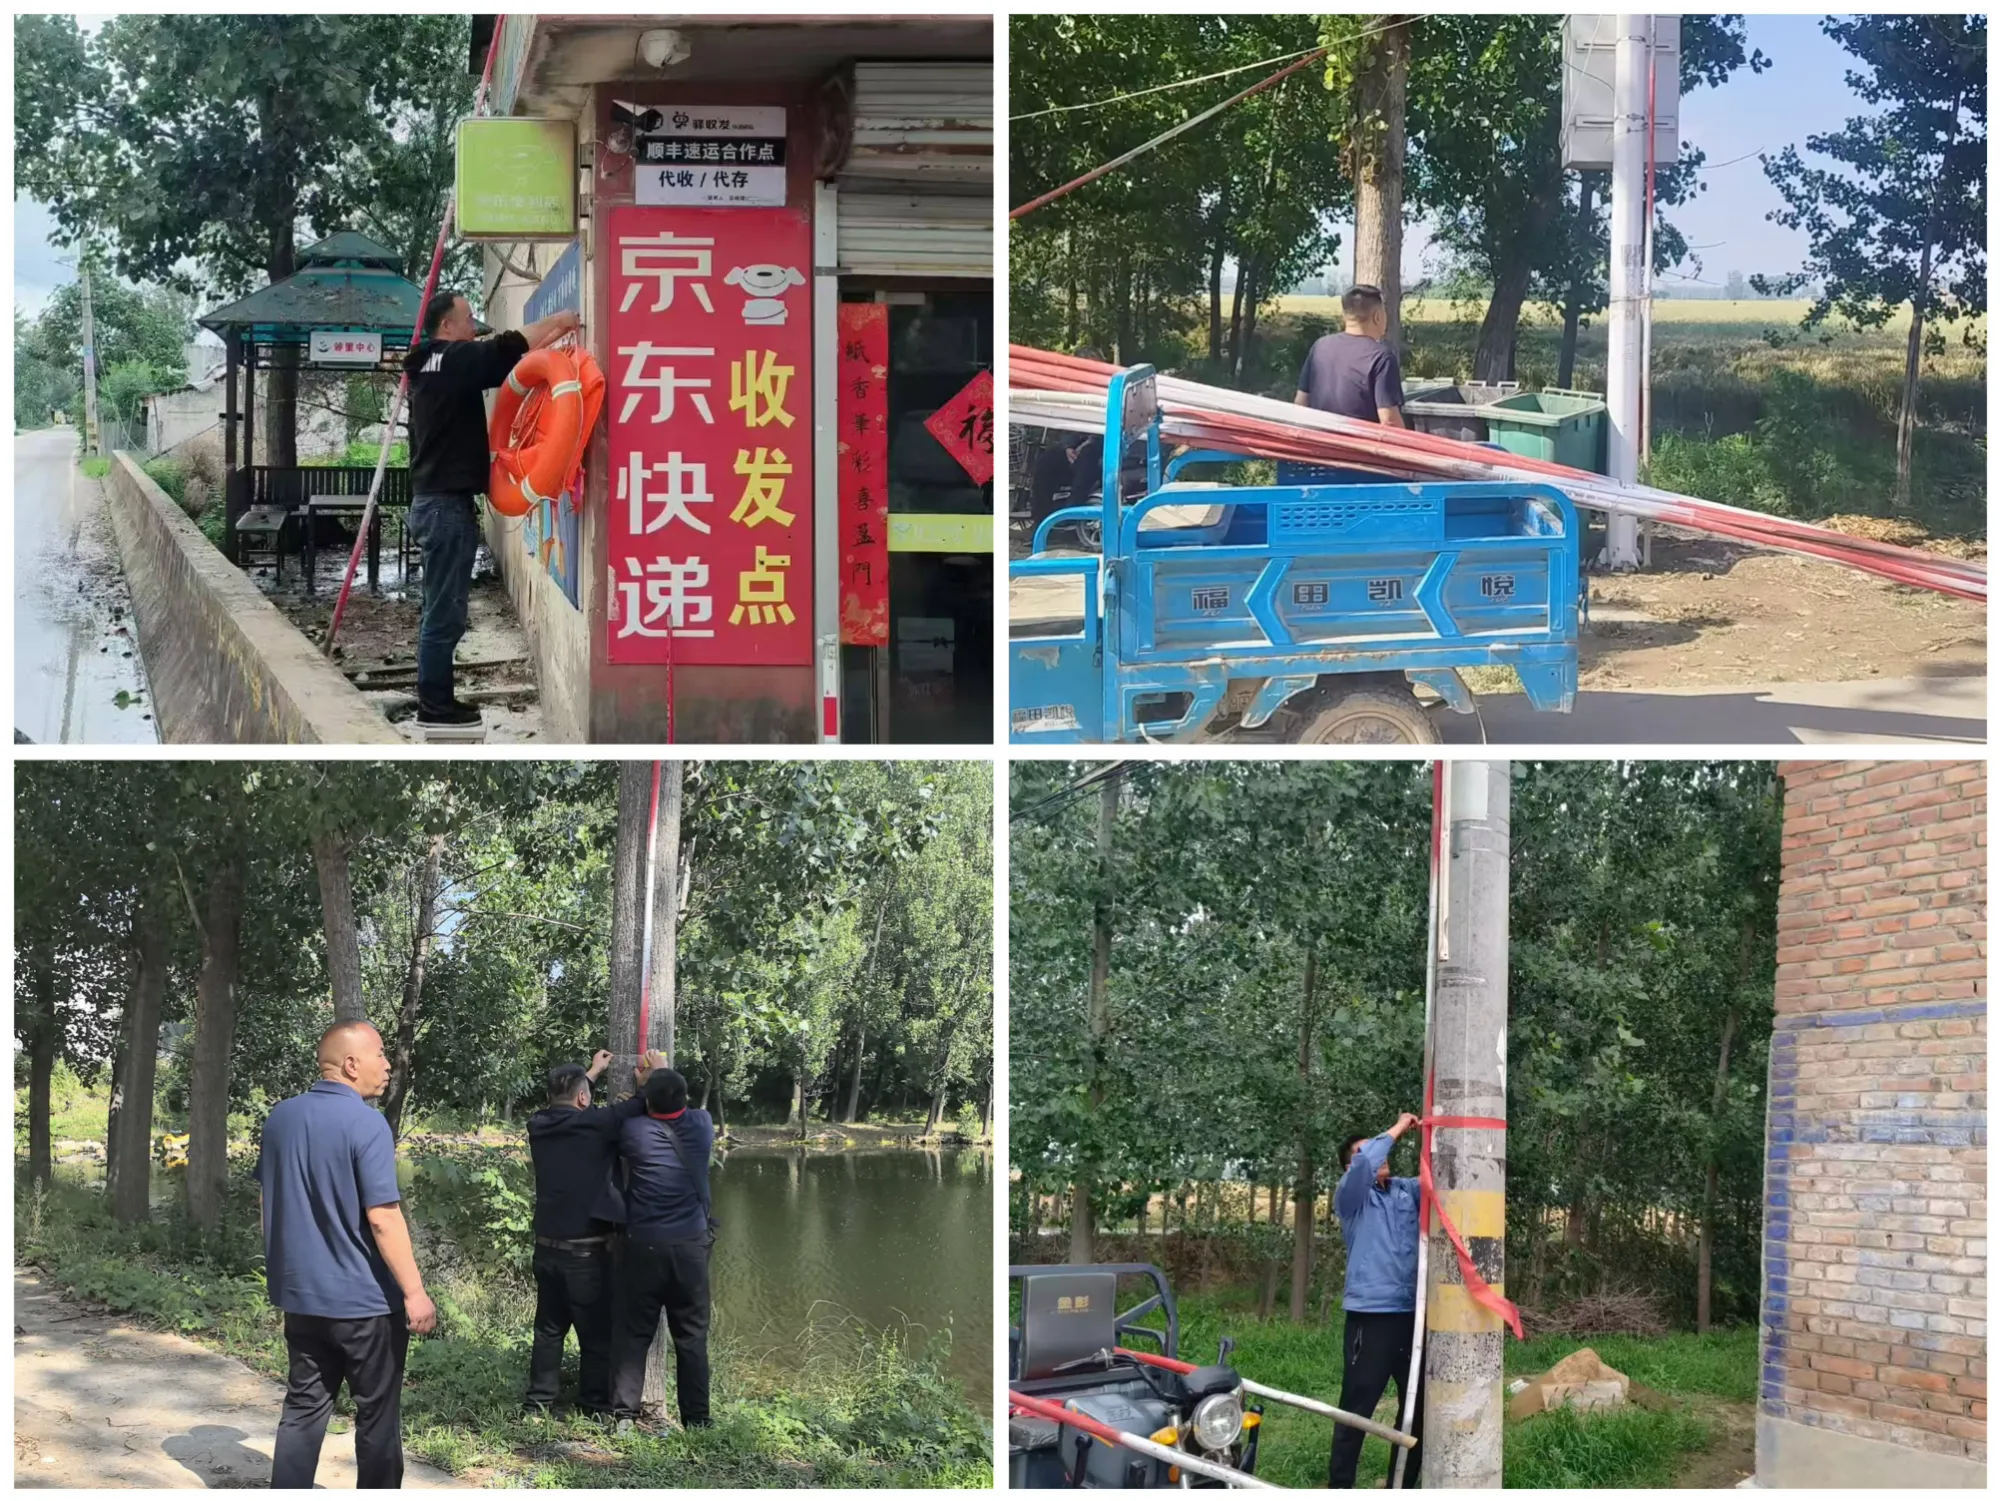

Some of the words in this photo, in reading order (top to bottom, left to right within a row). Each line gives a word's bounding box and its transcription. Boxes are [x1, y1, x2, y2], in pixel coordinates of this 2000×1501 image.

[646, 142, 775, 160] 顺丰速运合作点
[658, 170, 694, 188] 代收
[713, 170, 749, 188] 代存
[617, 231, 715, 638] 京东快递
[728, 349, 796, 626] 收发点
